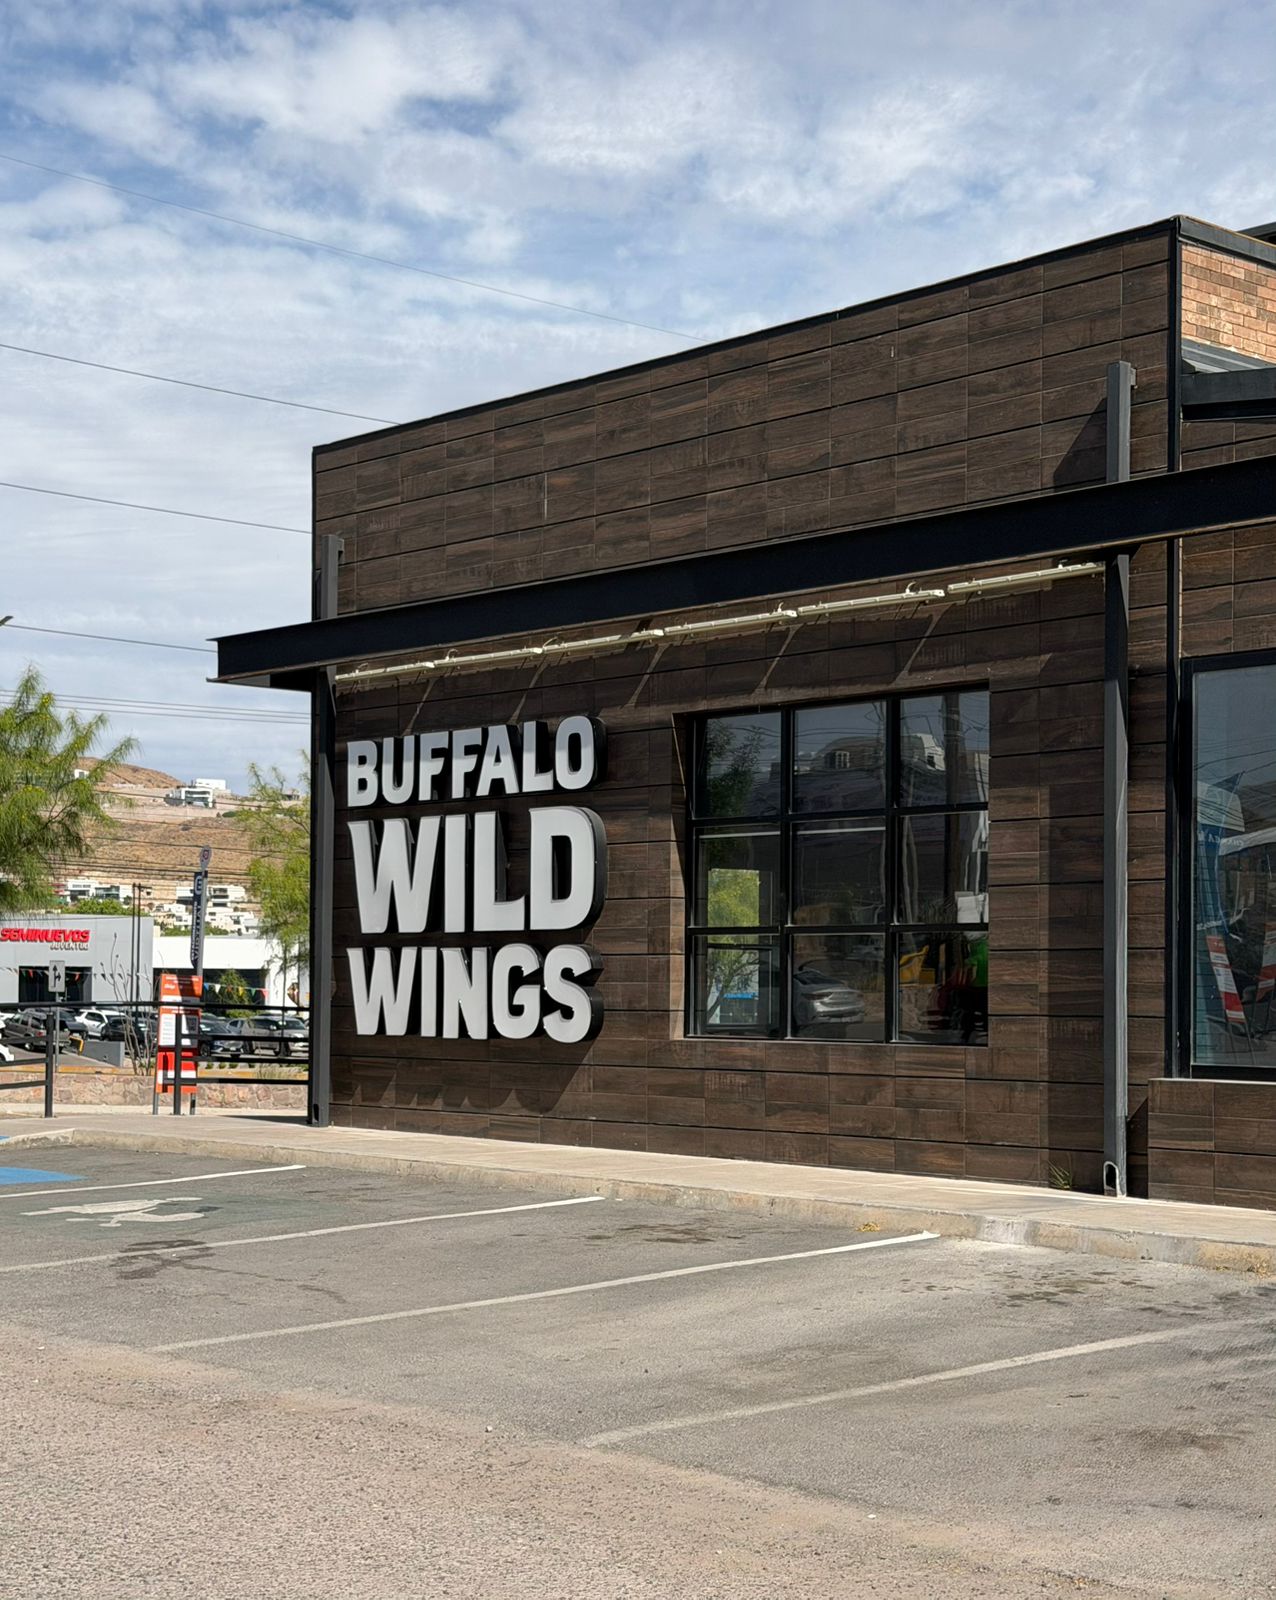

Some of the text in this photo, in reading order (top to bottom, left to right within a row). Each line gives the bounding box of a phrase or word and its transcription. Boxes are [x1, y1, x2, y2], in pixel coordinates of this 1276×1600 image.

[347, 715, 595, 807] BUFFALO
[347, 806, 597, 934] WILD
[0, 928, 90, 942] SEMINUEVOS
[347, 943, 594, 1044] WINGS
